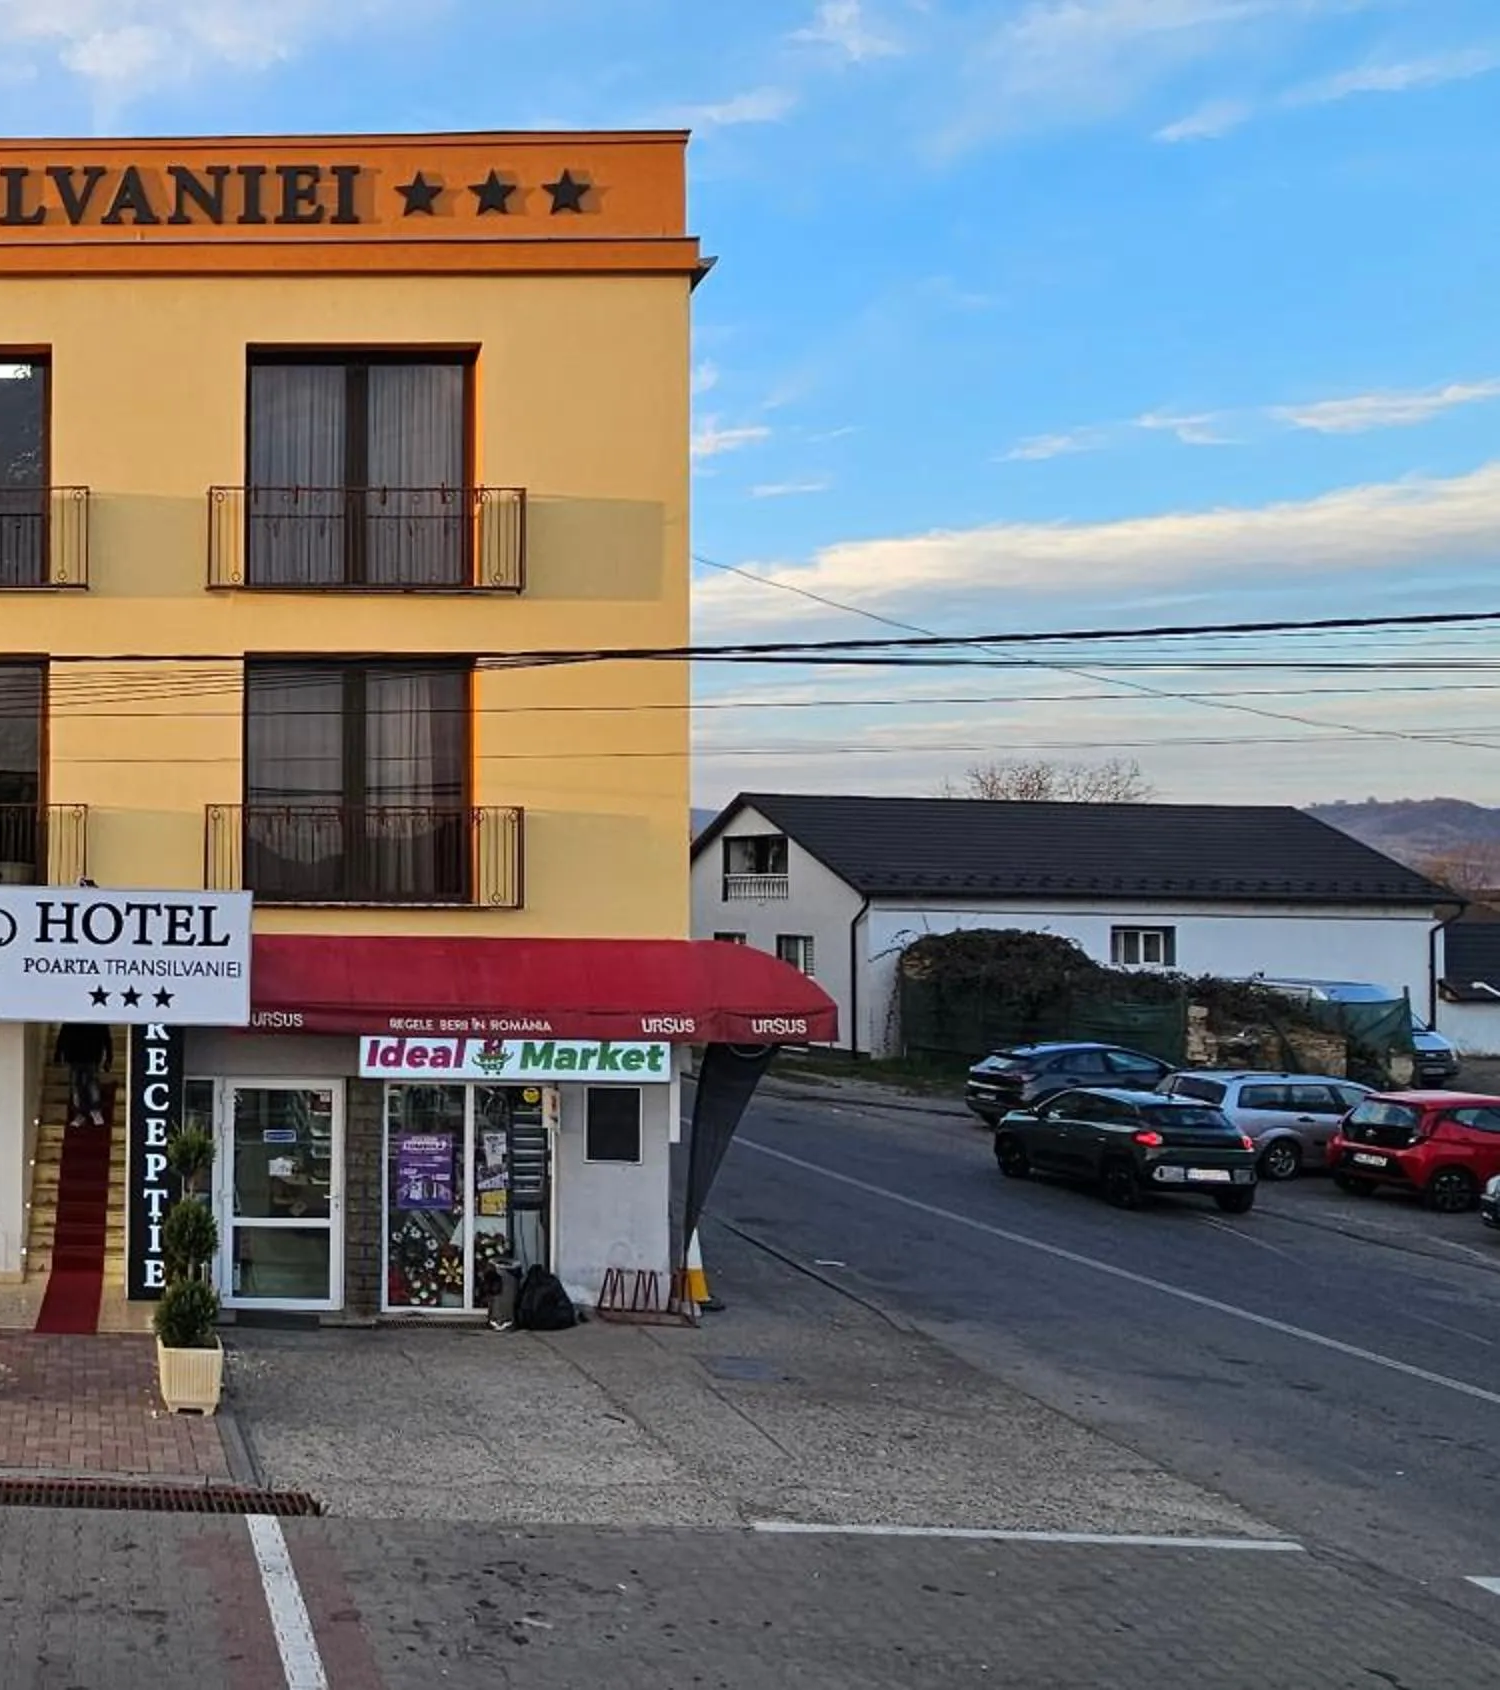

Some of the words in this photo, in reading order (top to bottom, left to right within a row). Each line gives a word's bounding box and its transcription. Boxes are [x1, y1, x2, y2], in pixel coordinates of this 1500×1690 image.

[34, 901, 231, 947] HOTEL
[23, 957, 100, 975] POARTA
[103, 959, 242, 978] TRANSILVANIEI
[252, 1011, 304, 1027] URSUS
[389, 1017, 433, 1031] REGELE
[641, 1017, 695, 1034] URSUS
[752, 1018, 807, 1035] URSUS
[366, 1038, 468, 1069] Ideal
[519, 1041, 665, 1072] Market
